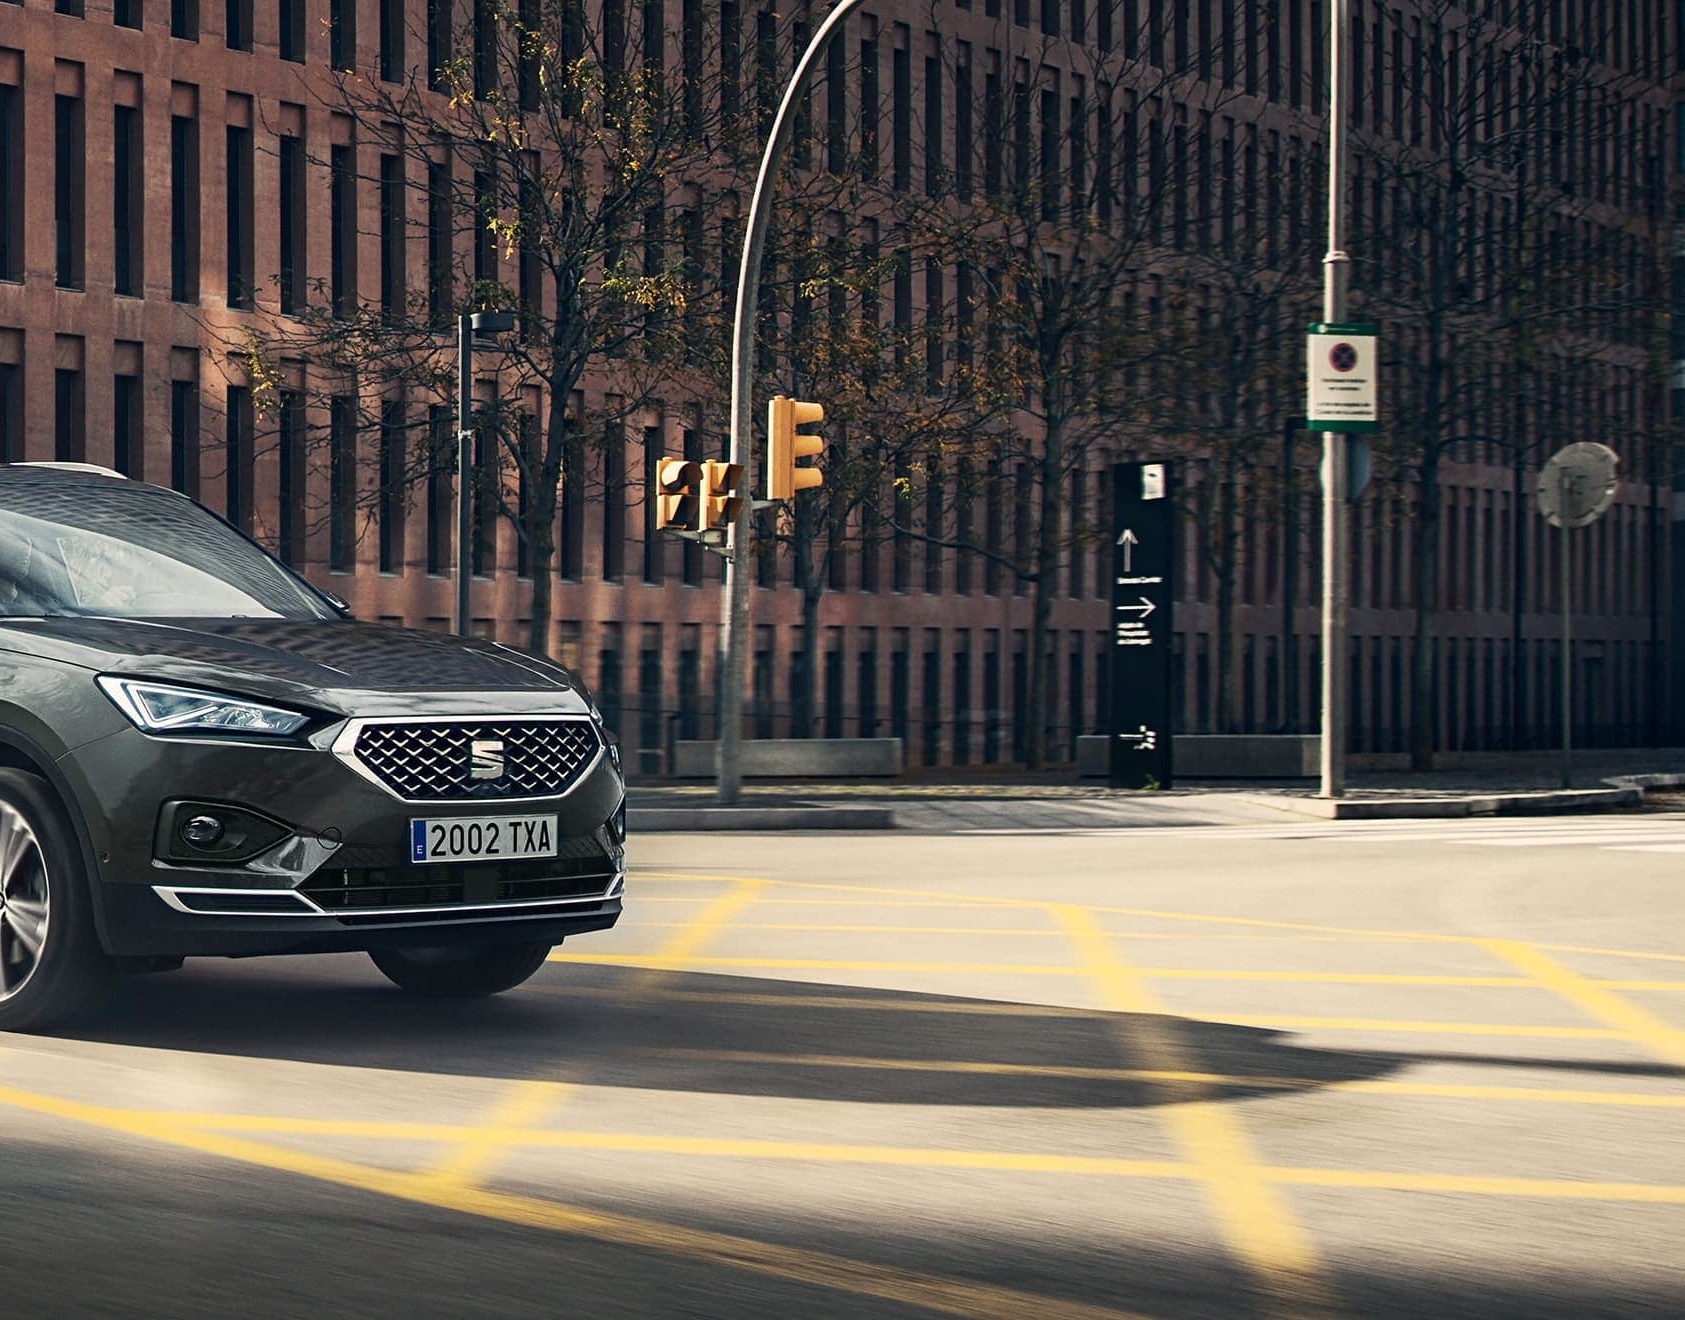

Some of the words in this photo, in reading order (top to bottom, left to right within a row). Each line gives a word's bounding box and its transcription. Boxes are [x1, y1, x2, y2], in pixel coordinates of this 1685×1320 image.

[417, 845, 423, 854] E
[431, 823, 500, 857] 2002
[509, 820, 551, 853] TXA
